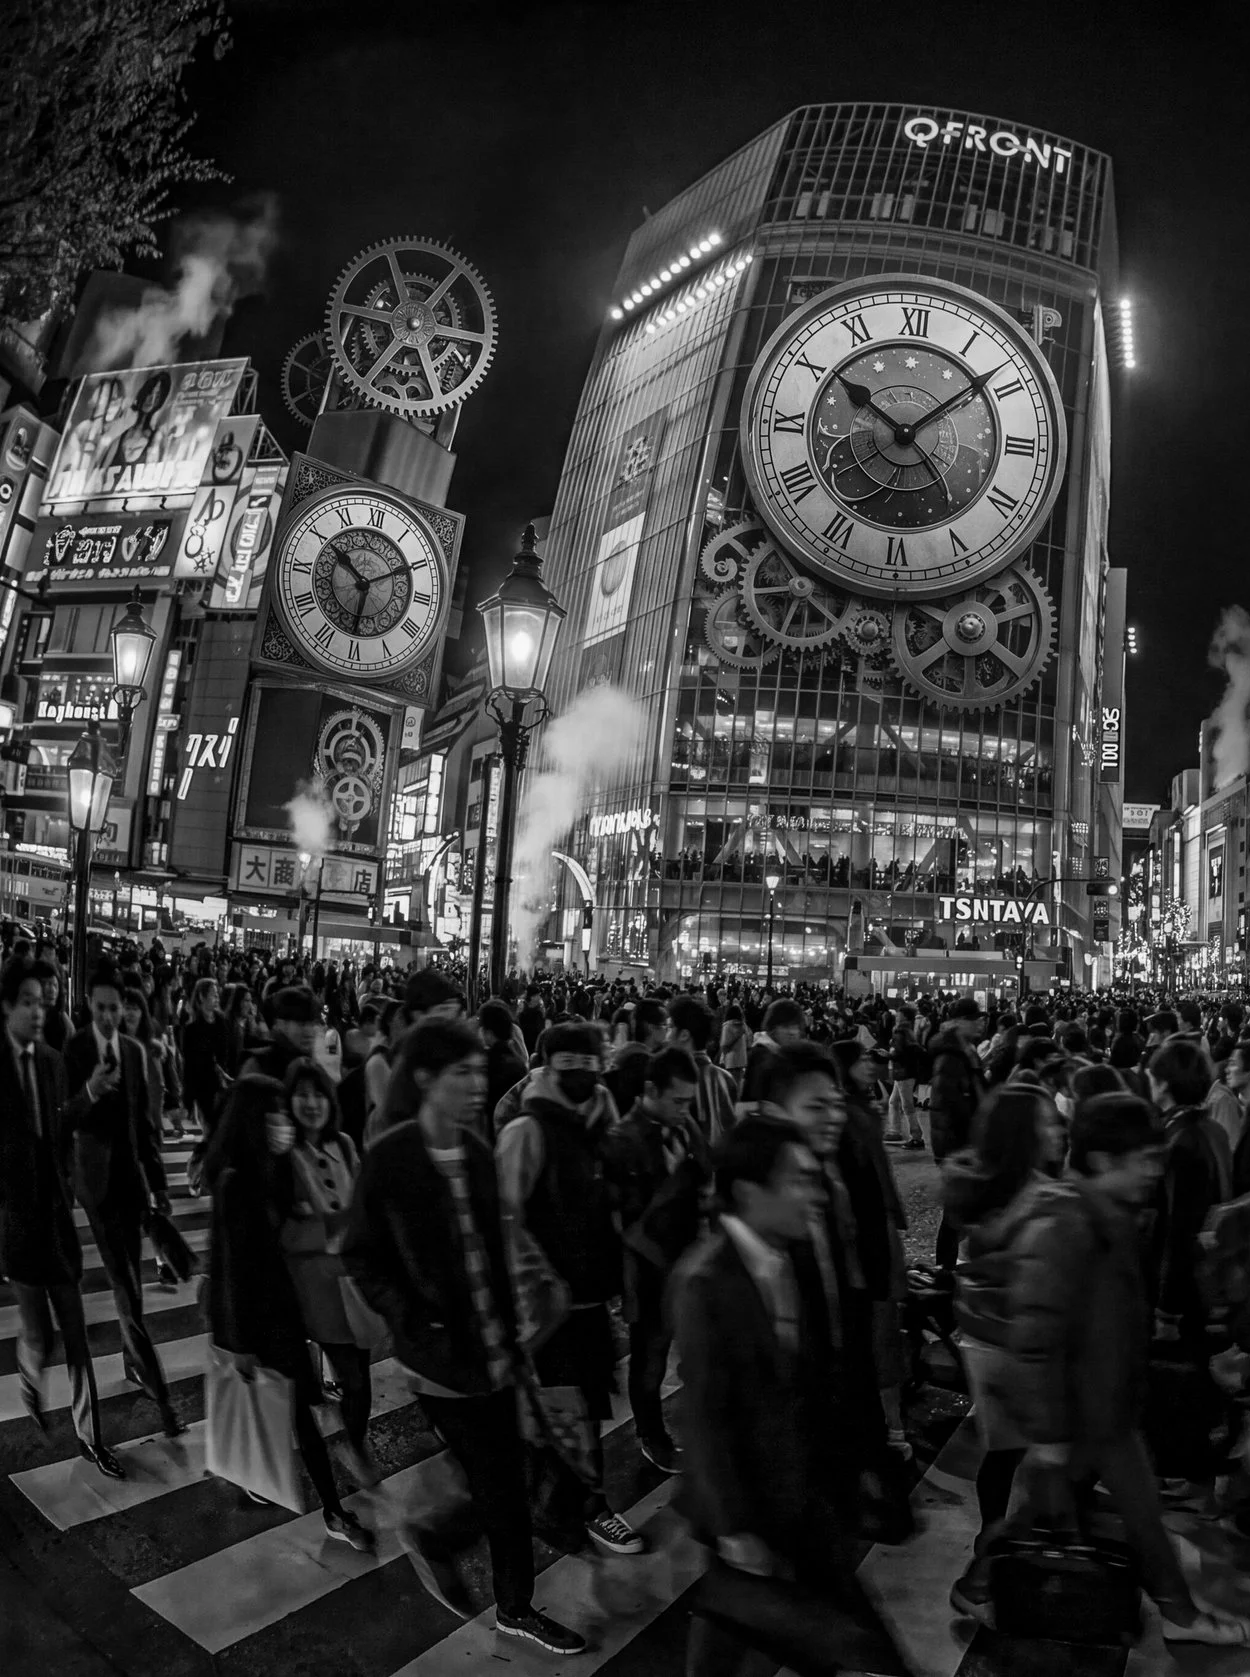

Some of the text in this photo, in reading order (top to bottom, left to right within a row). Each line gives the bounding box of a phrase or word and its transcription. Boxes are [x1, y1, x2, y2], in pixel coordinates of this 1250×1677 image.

[904, 117, 1072, 174] QFRONT
[840, 313, 873, 348] XI
[898, 307, 931, 338] XII
[958, 330, 980, 357] I
[794, 351, 827, 382] X
[993, 377, 1025, 401] II
[773, 409, 805, 435] IX
[1004, 434, 1035, 458] III
[779, 460, 818, 505] VIII
[986, 485, 1019, 519] IV
[335, 507, 354, 529] XI
[367, 507, 385, 529] XII
[821, 511, 854, 550] VII
[309, 525, 328, 544] X
[397, 529, 409, 543] I
[948, 527, 968, 556] V
[885, 536, 908, 566] VI
[292, 558, 313, 575] IX
[294, 591, 317, 618] VIII
[413, 590, 431, 606] III
[314, 623, 336, 649] VII
[382, 639, 392, 658] V
[348, 640, 360, 661] VI
